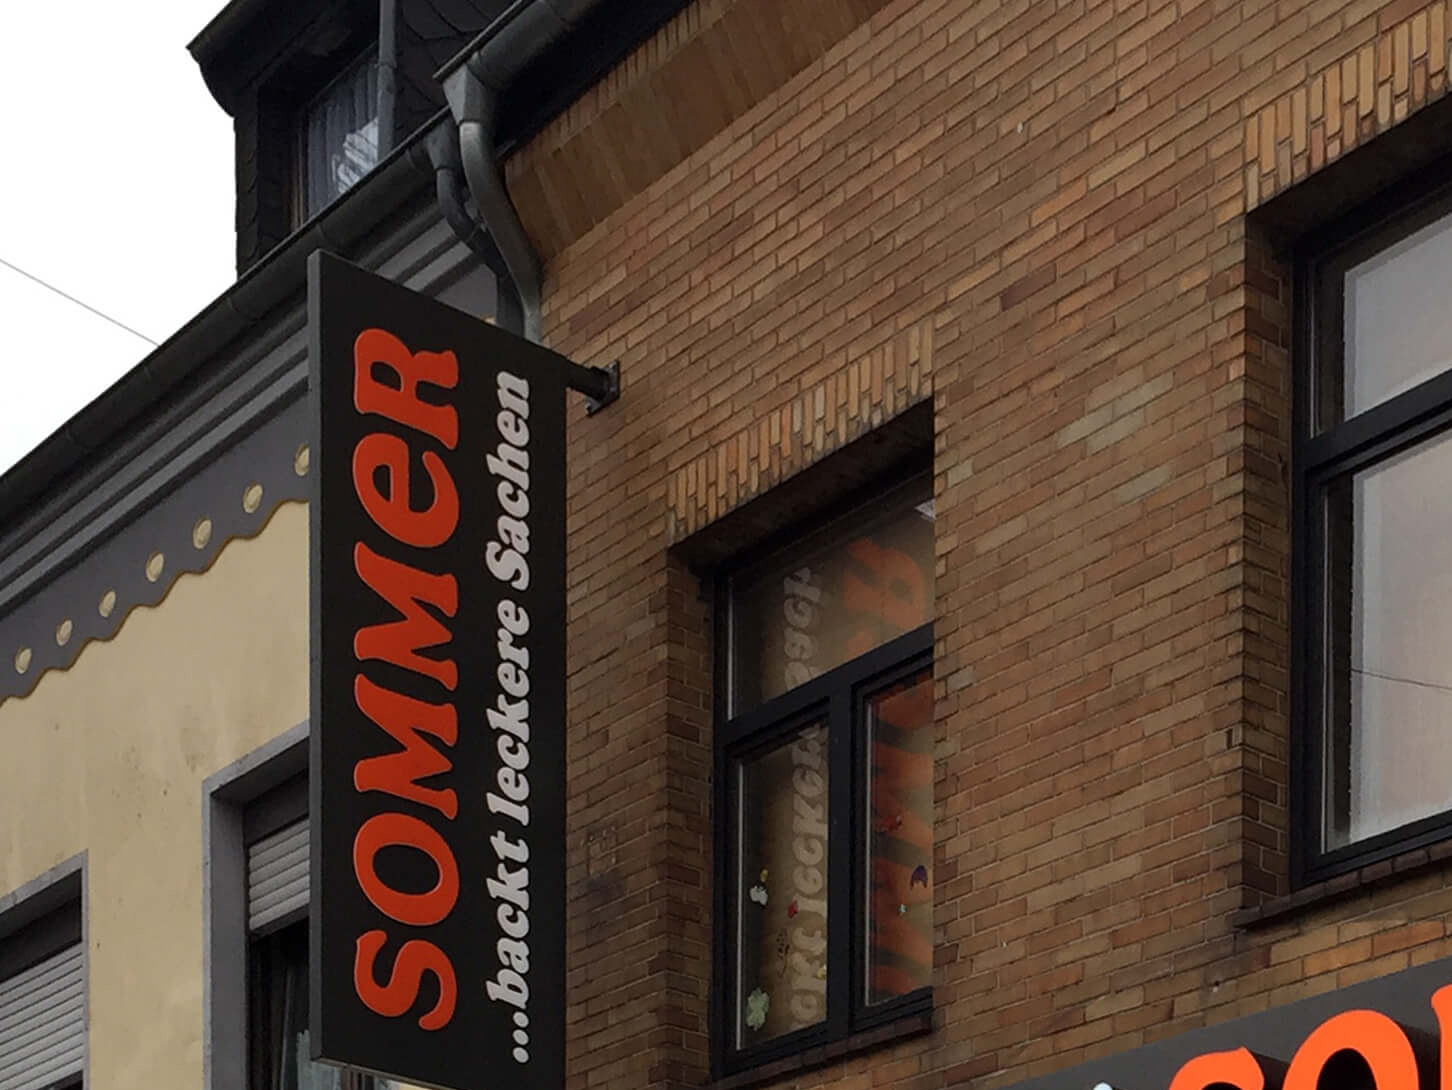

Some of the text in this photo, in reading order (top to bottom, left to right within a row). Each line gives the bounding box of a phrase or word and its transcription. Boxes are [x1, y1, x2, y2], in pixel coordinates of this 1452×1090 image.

[486, 370, 531, 1064] ...backt leckere Sachen
